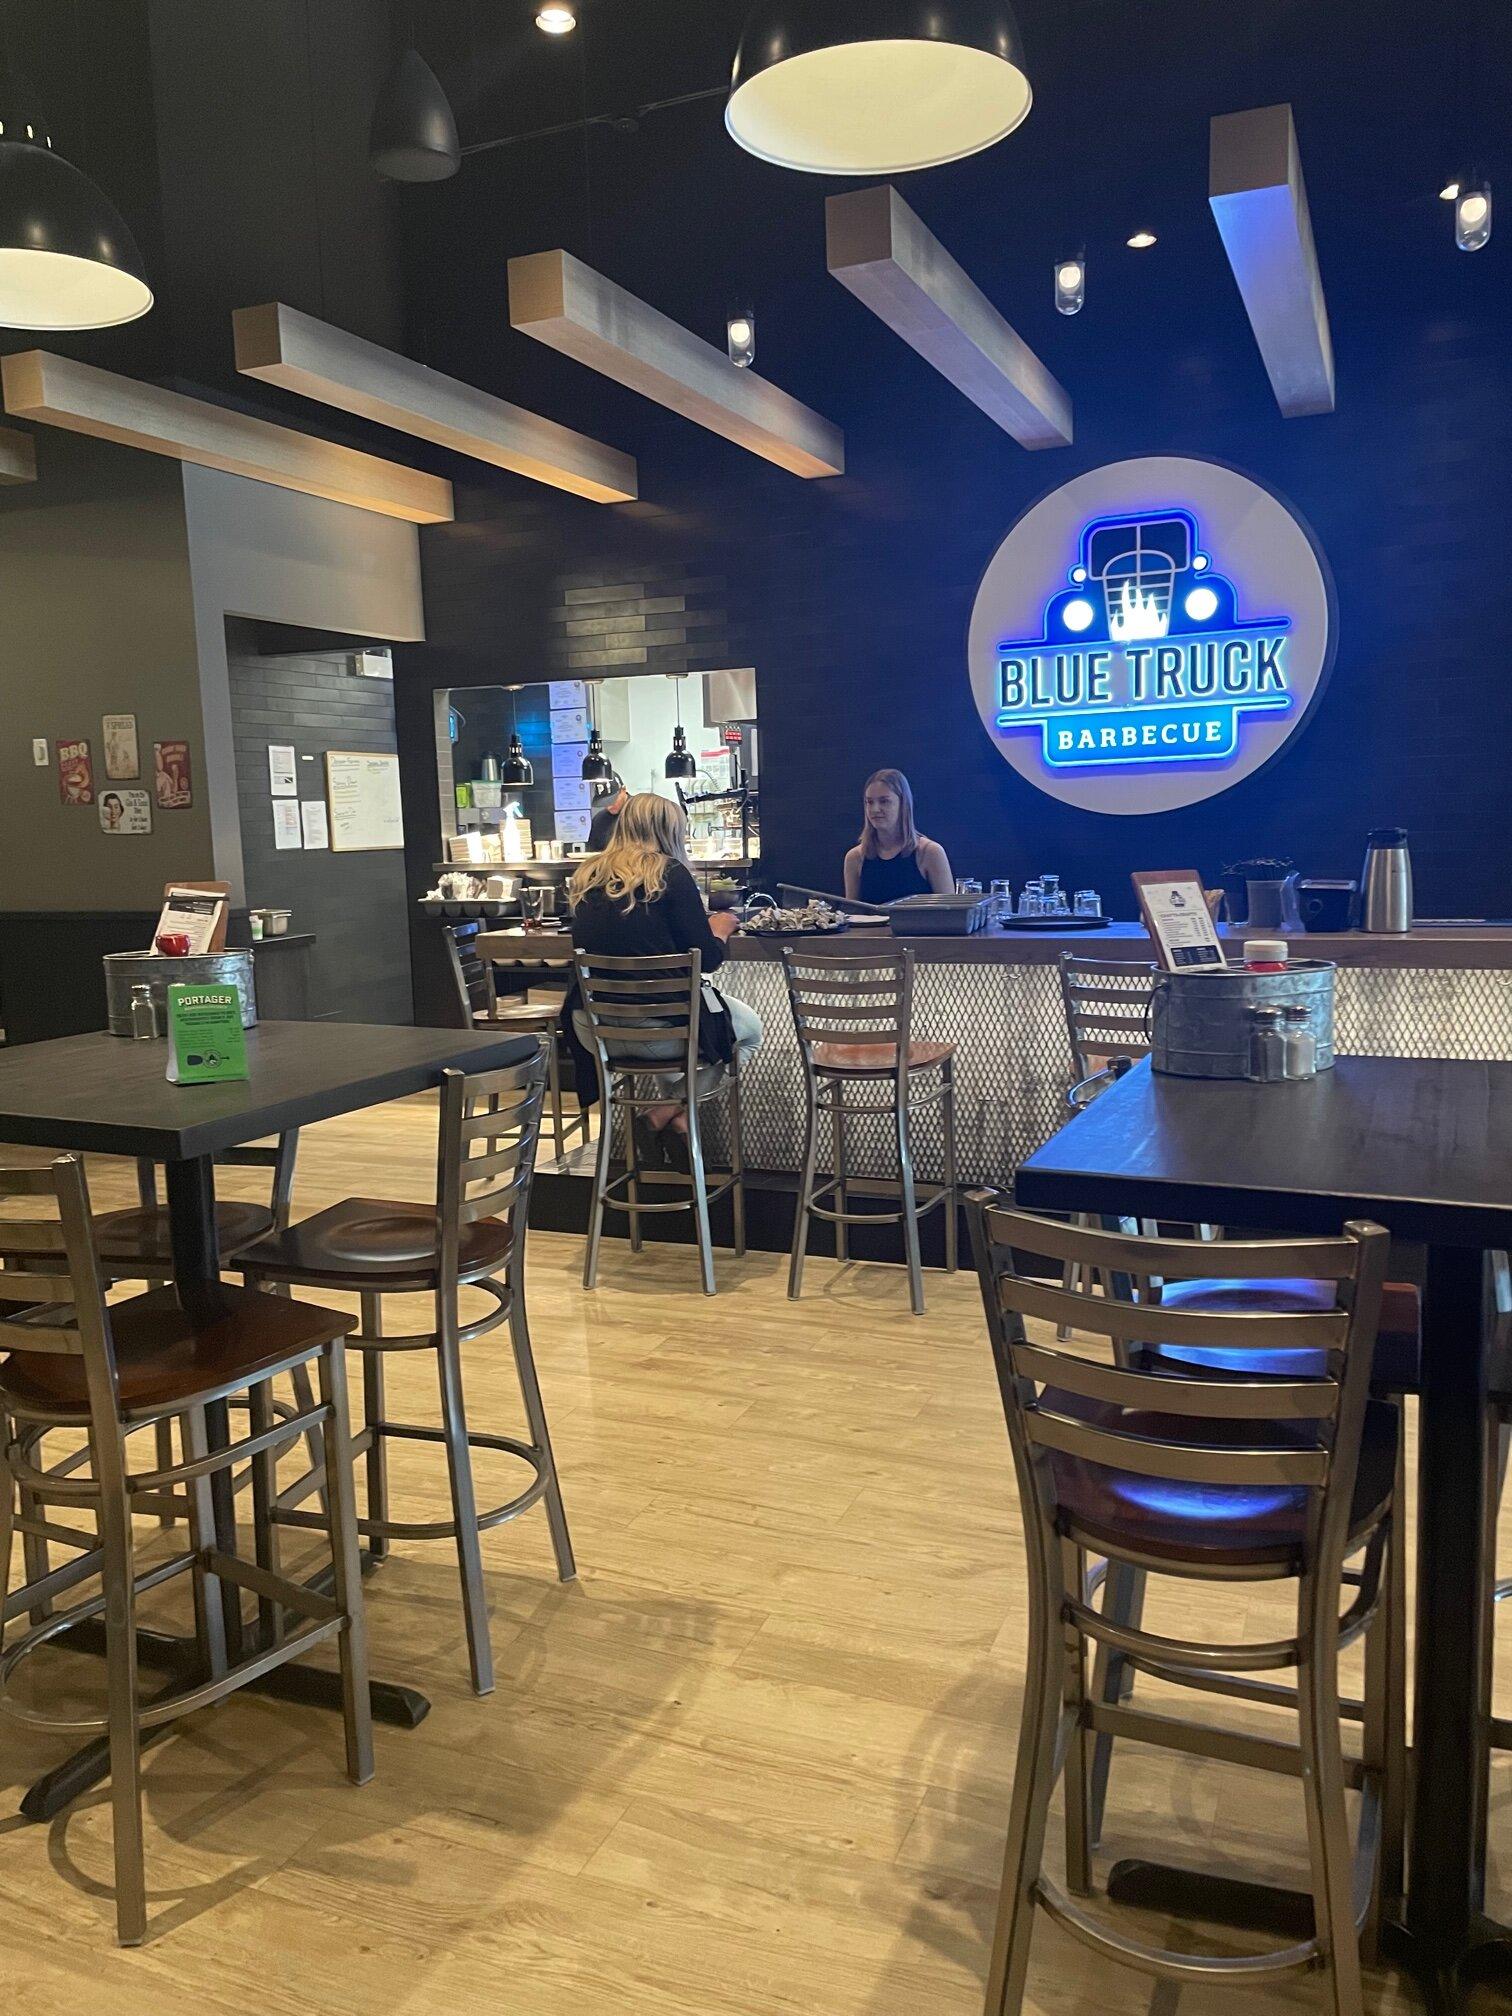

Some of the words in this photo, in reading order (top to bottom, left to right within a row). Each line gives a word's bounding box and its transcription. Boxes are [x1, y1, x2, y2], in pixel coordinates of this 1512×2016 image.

[1000, 652, 1110, 708] BLUE
[1125, 637, 1287, 698] TRUCK
[1057, 720, 1223, 750] BARBECUE
[59, 742, 88, 760] BBQ
[177, 995, 232, 1006] PORTAGER
